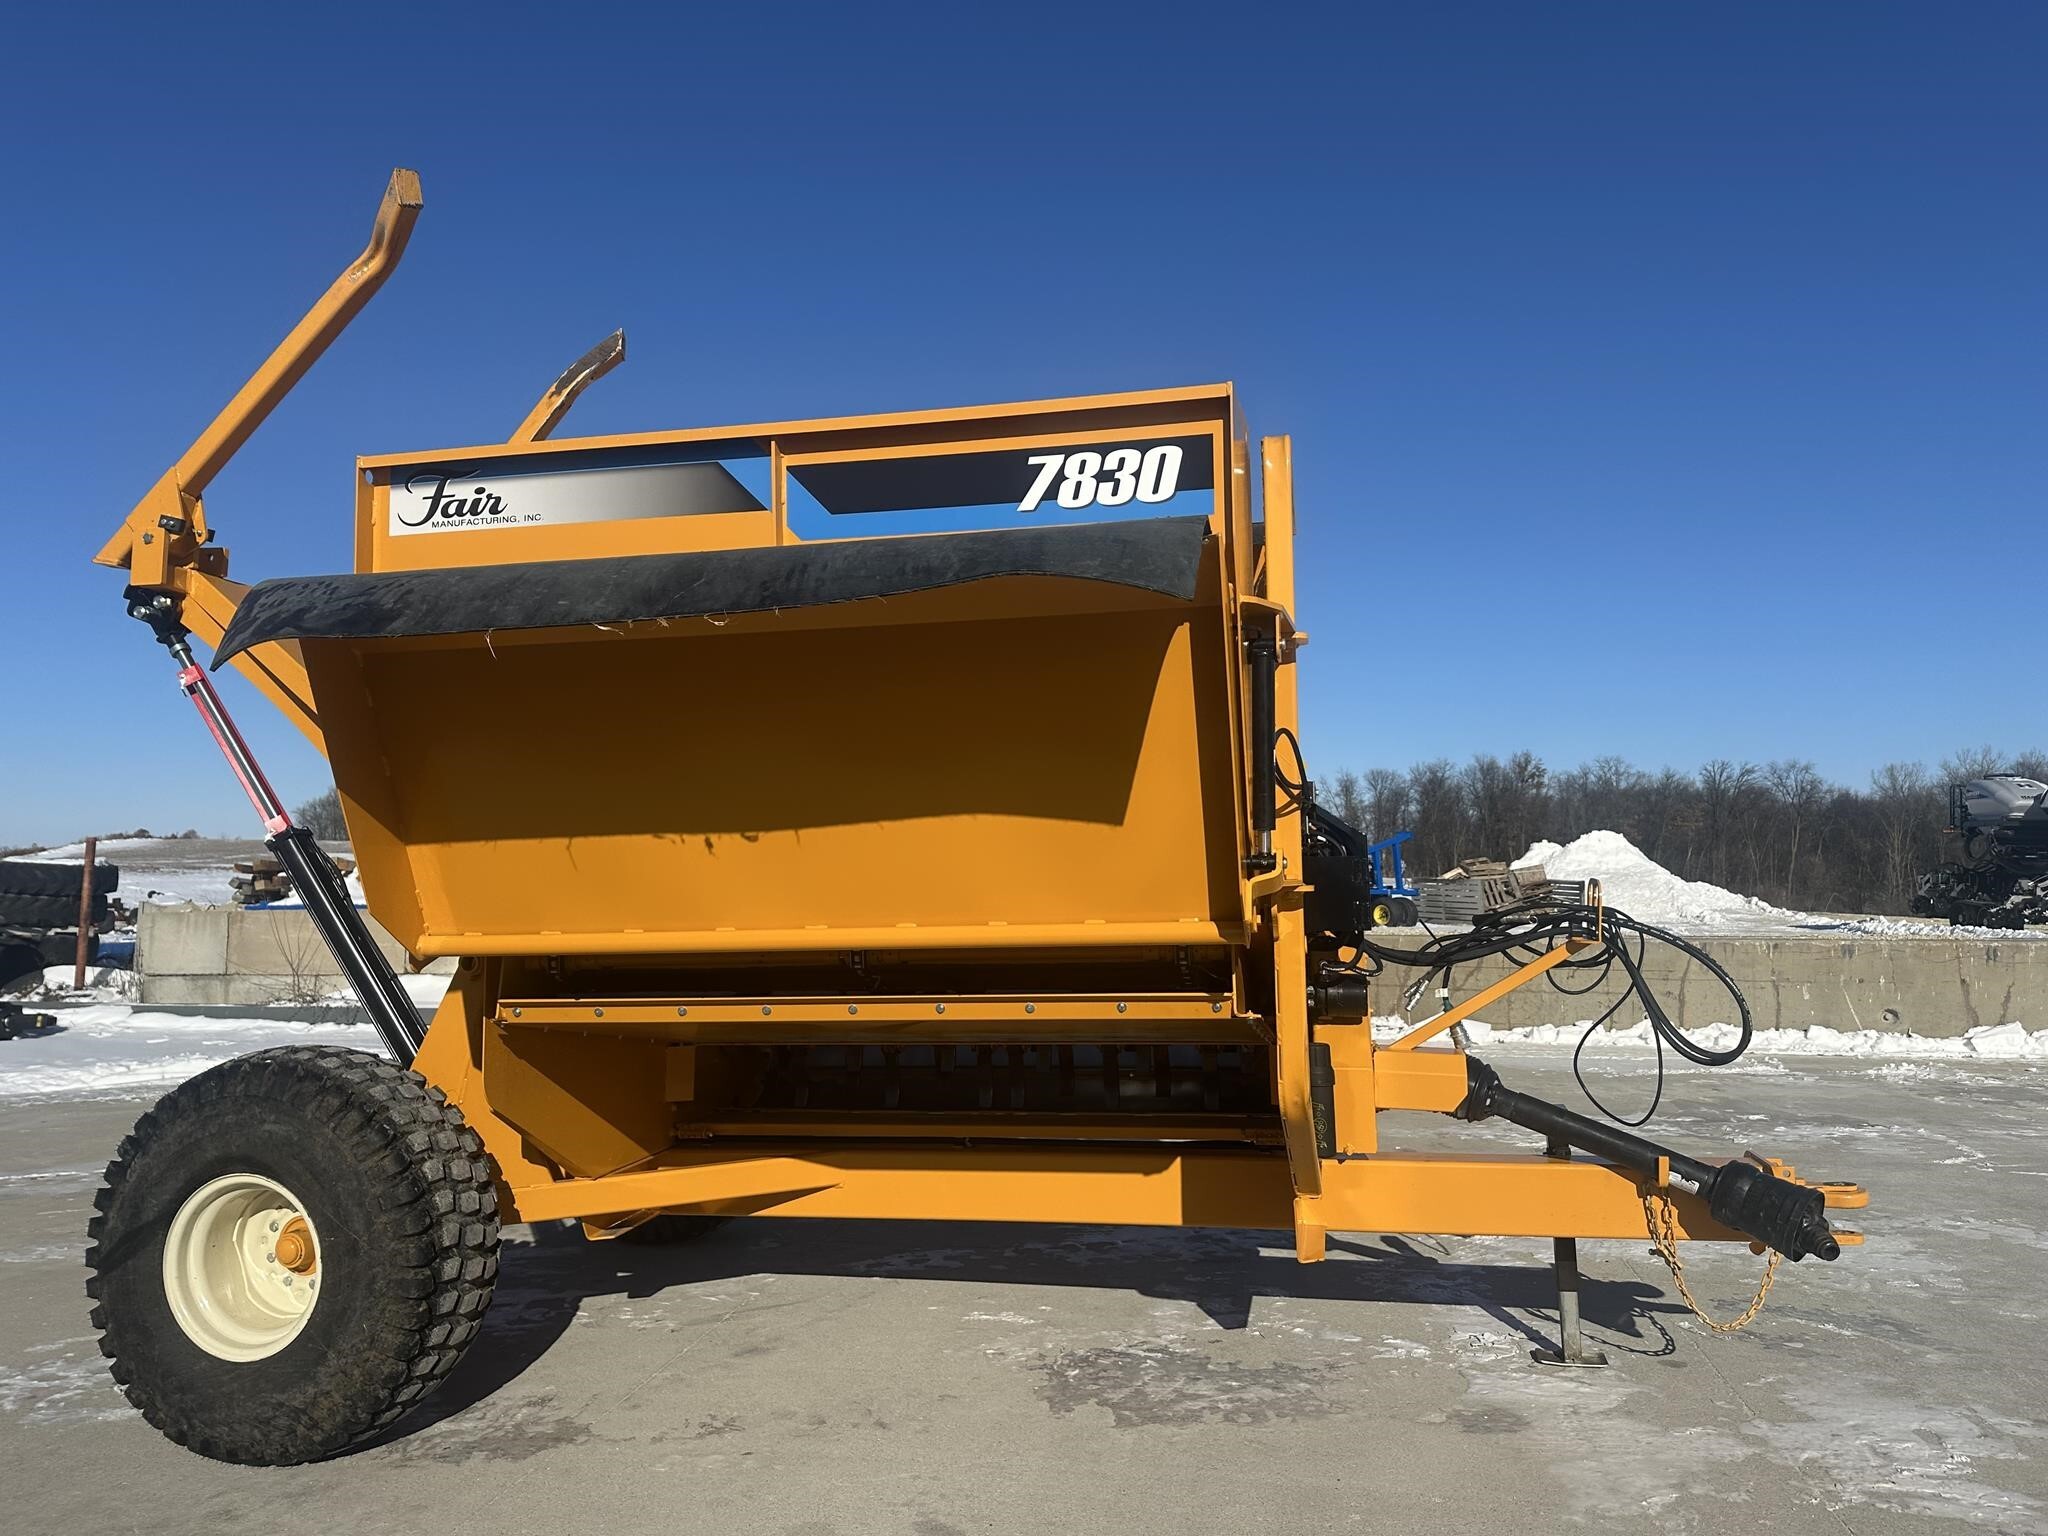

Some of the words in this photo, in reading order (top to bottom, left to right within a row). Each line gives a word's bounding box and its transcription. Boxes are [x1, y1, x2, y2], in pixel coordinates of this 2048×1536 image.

[397, 468, 508, 527] Fair
[1017, 445, 1184, 512] 7830
[431, 515, 520, 528] MANUFACTURING,
